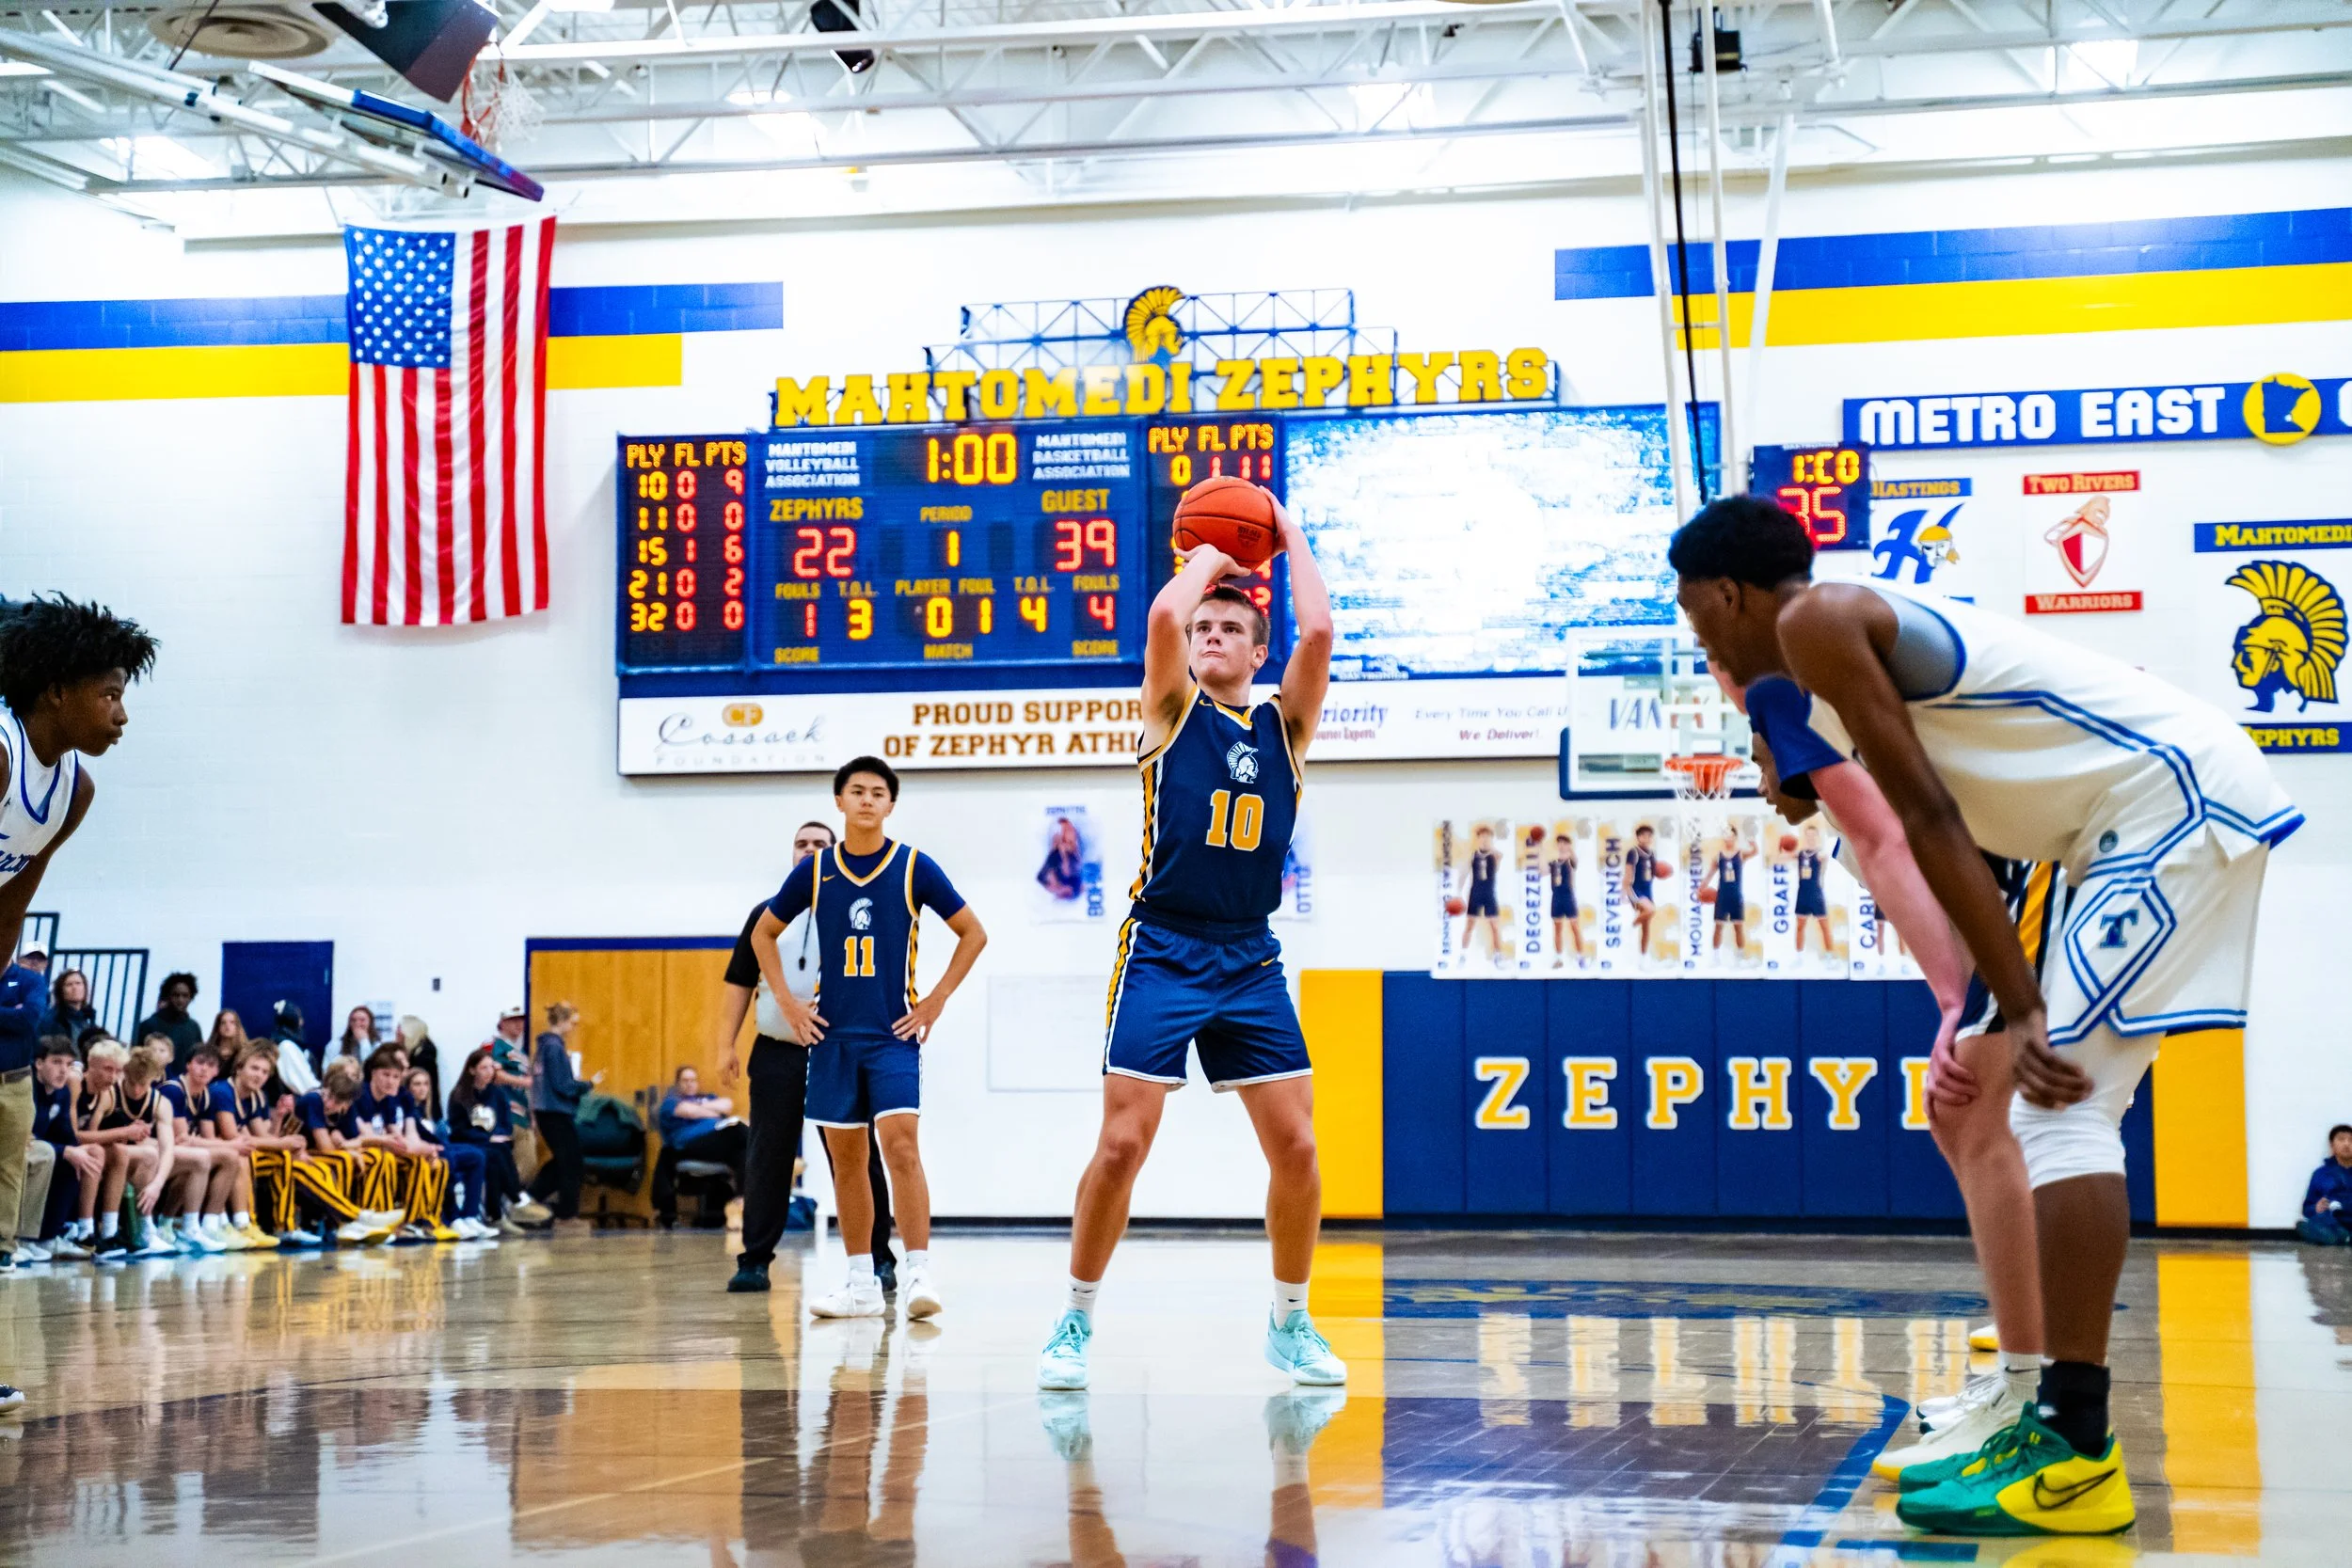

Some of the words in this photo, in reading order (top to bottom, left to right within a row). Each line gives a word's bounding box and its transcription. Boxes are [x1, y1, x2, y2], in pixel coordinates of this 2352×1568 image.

[774, 361, 1192, 427] MAHTOMEDI
[1216, 347, 1549, 411] ZEPHYRS
[1860, 394, 2056, 445] METRO
[2080, 387, 2225, 437] EAST
[1149, 427, 1189, 453] PLY
[1197, 425, 1226, 451] FL
[1231, 423, 1274, 451] PTS
[627, 443, 666, 468] PLY
[675, 442, 700, 467] FL
[706, 441, 747, 467] PTS
[765, 457, 861, 473] VOLLEYBALL
[928, 433, 1017, 485] 1:00
[1032, 448, 1130, 465] BASKETBALL
[1170, 454, 1191, 486] 0
[638, 471, 668, 500] 10
[675, 470, 697, 499] 0
[723, 468, 744, 497] 9
[765, 473, 861, 488] ASSOCIATION
[2028, 474, 2070, 494] TWO
[2072, 473, 2136, 492] RIVERS
[770, 497, 864, 521] ZEPHYRS
[920, 505, 973, 523] PERIOD
[1041, 488, 1110, 513] GUEST
[638, 505, 668, 531] 11
[675, 502, 697, 532] 0
[723, 501, 744, 531] 0
[638, 536, 668, 565] 15
[685, 538, 697, 563] 1
[723, 534, 744, 564] 6
[946, 530, 961, 566] 1
[1055, 518, 1117, 572] 39
[2216, 524, 2352, 546] MAHTOMEDI
[793, 527, 857, 578] 22
[628, 569, 668, 599] 21
[675, 567, 697, 598] 0
[723, 567, 744, 597] 2
[775, 582, 820, 599] FOULS
[895, 578, 951, 595] PLAYER
[959, 578, 996, 594] FOUL
[1073, 574, 1120, 592] FOULS
[630, 602, 667, 632] 32
[675, 601, 697, 631] 0
[723, 600, 744, 630] 0
[1020, 595, 1047, 633] 4
[1089, 594, 1115, 631] 4
[2034, 594, 2134, 611] WARRIORS
[805, 603, 817, 638] 1
[848, 597, 873, 640] 3
[913, 702, 1014, 726] PROUD
[1025, 699, 1143, 723] SUPPOR
[883, 735, 920, 758] OF
[930, 732, 1055, 756] ZEPHYR
[1459, 729, 1481, 741] We
[1205, 788, 1264, 851] 10
[1605, 838, 1621, 948] SEVENICH
[1773, 863, 1789, 934] GRAFF
[844, 936, 876, 977] 11
